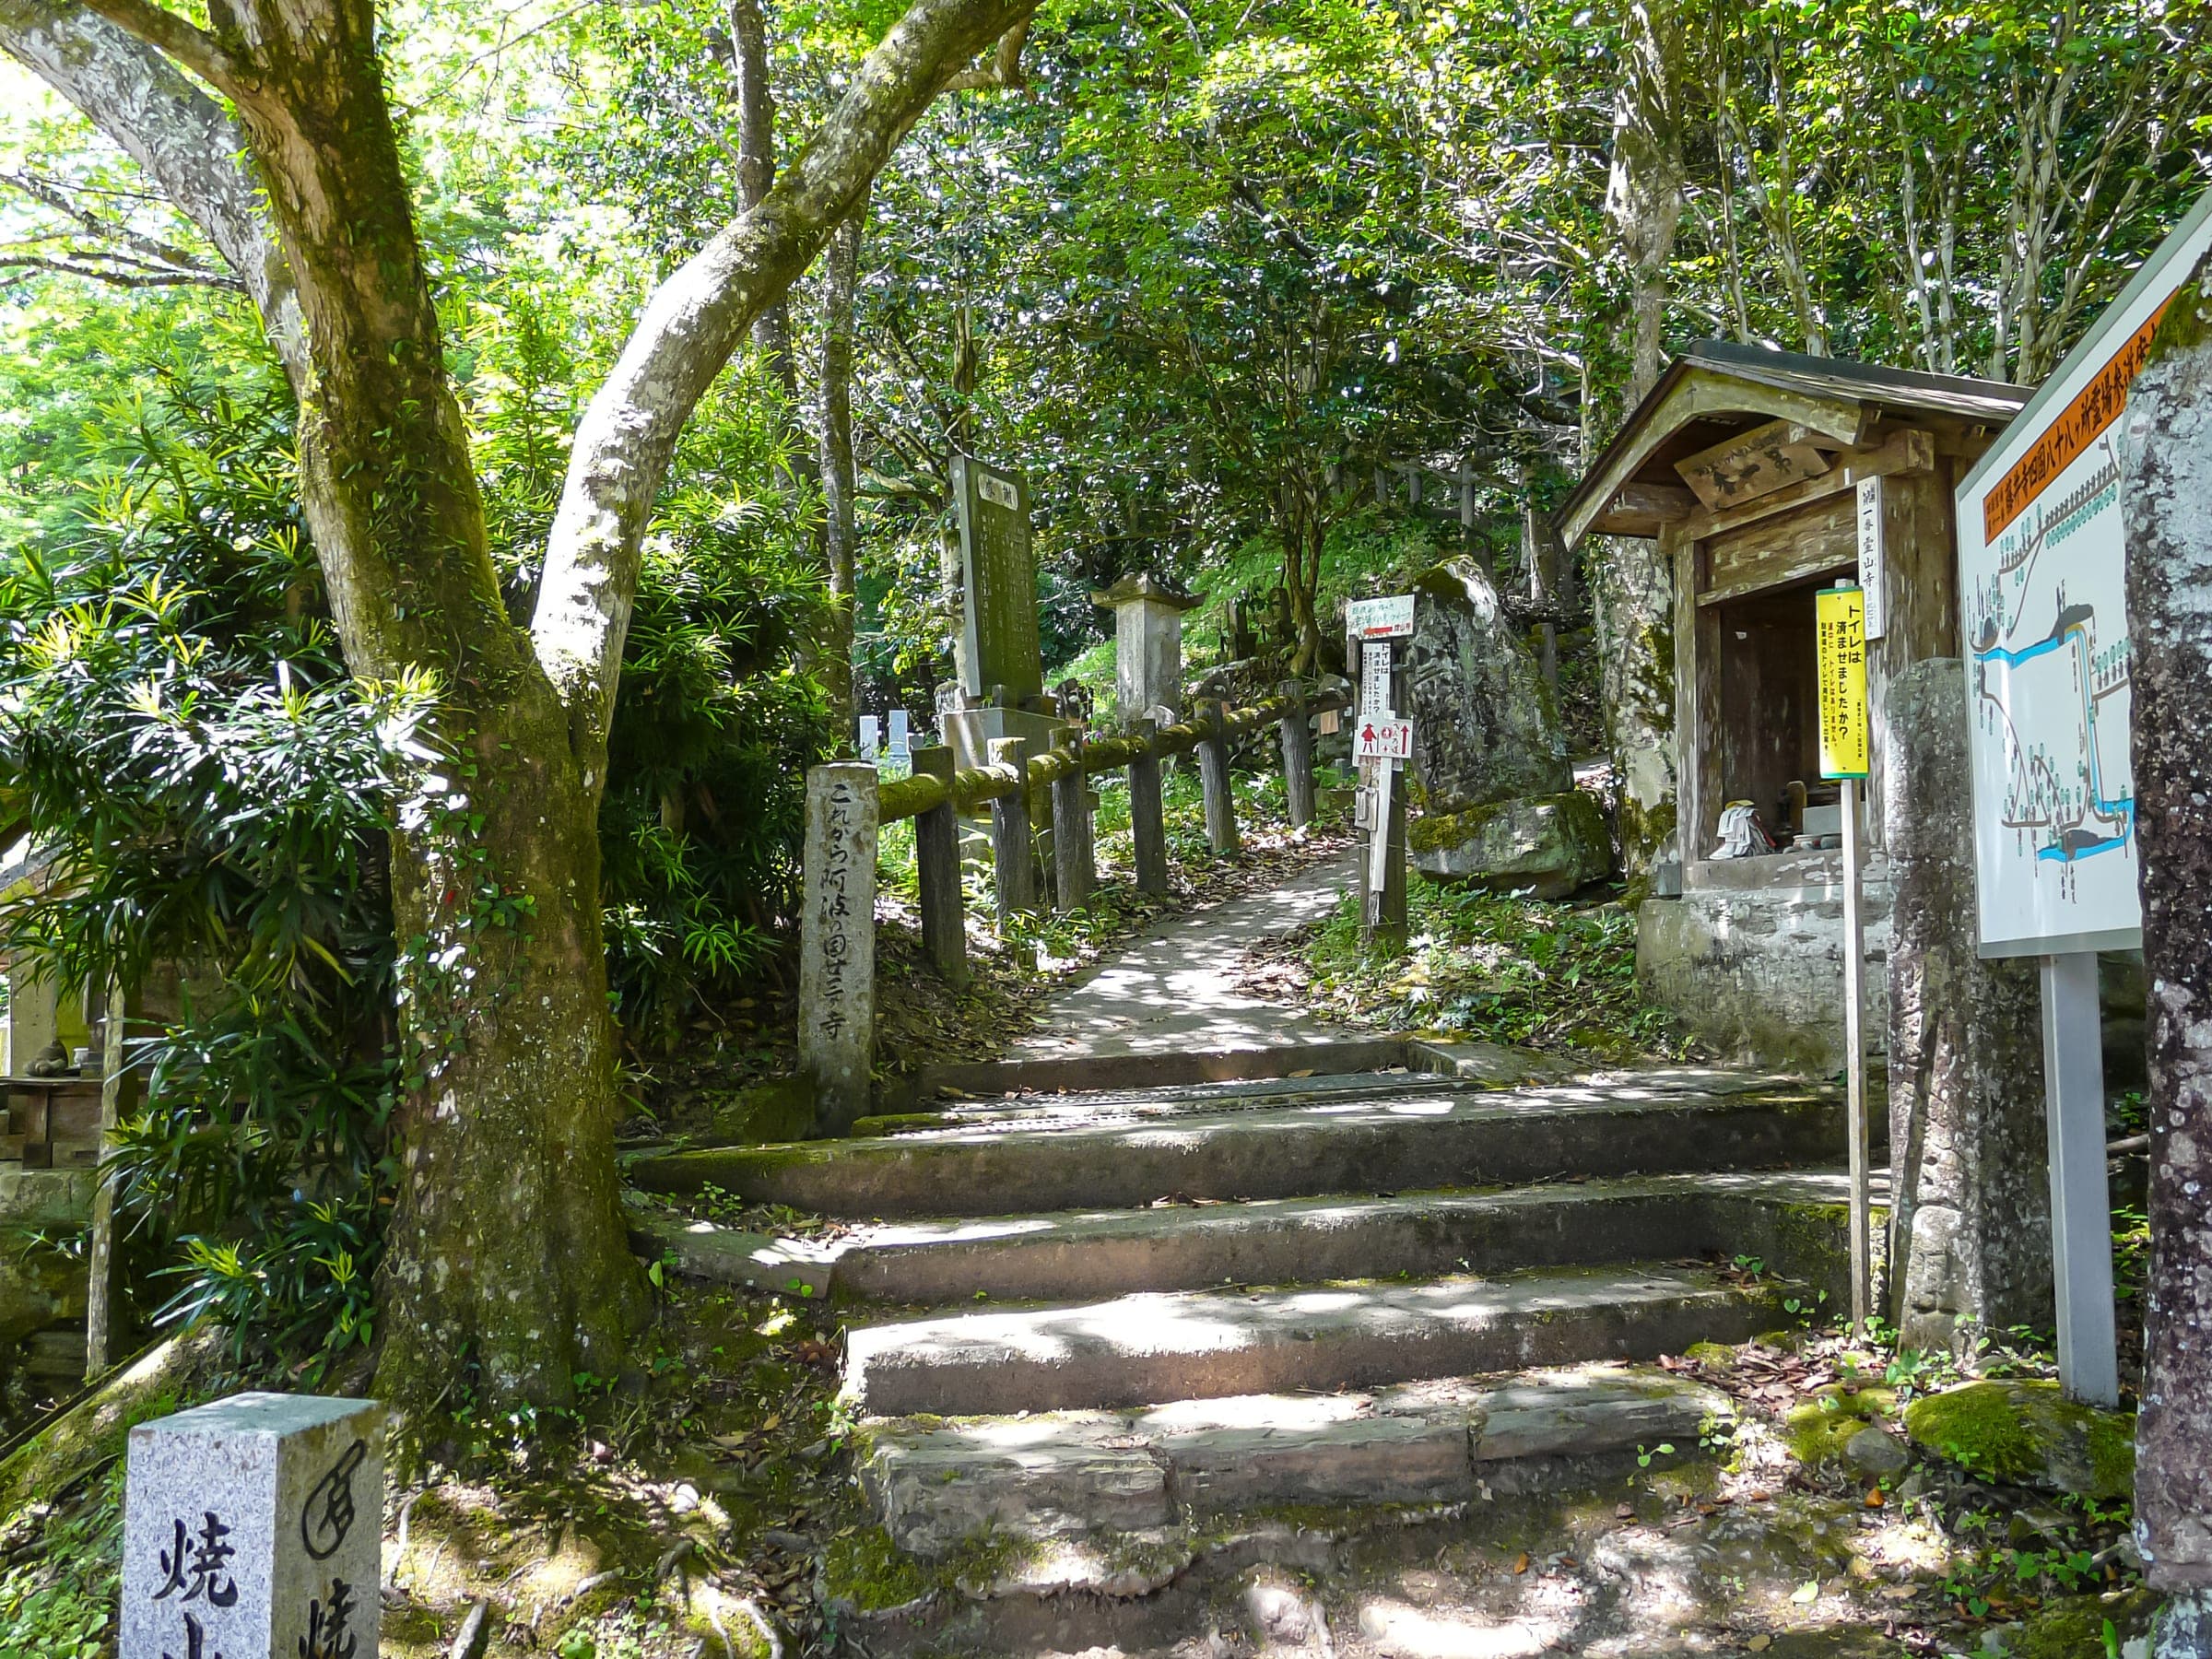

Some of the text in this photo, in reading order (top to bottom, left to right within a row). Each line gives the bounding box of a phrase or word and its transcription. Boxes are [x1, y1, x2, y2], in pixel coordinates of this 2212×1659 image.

[1848, 605, 1862, 664] トイレは
[1380, 643, 1391, 675] トイレは
[1391, 723, 1400, 755] へんろ道
